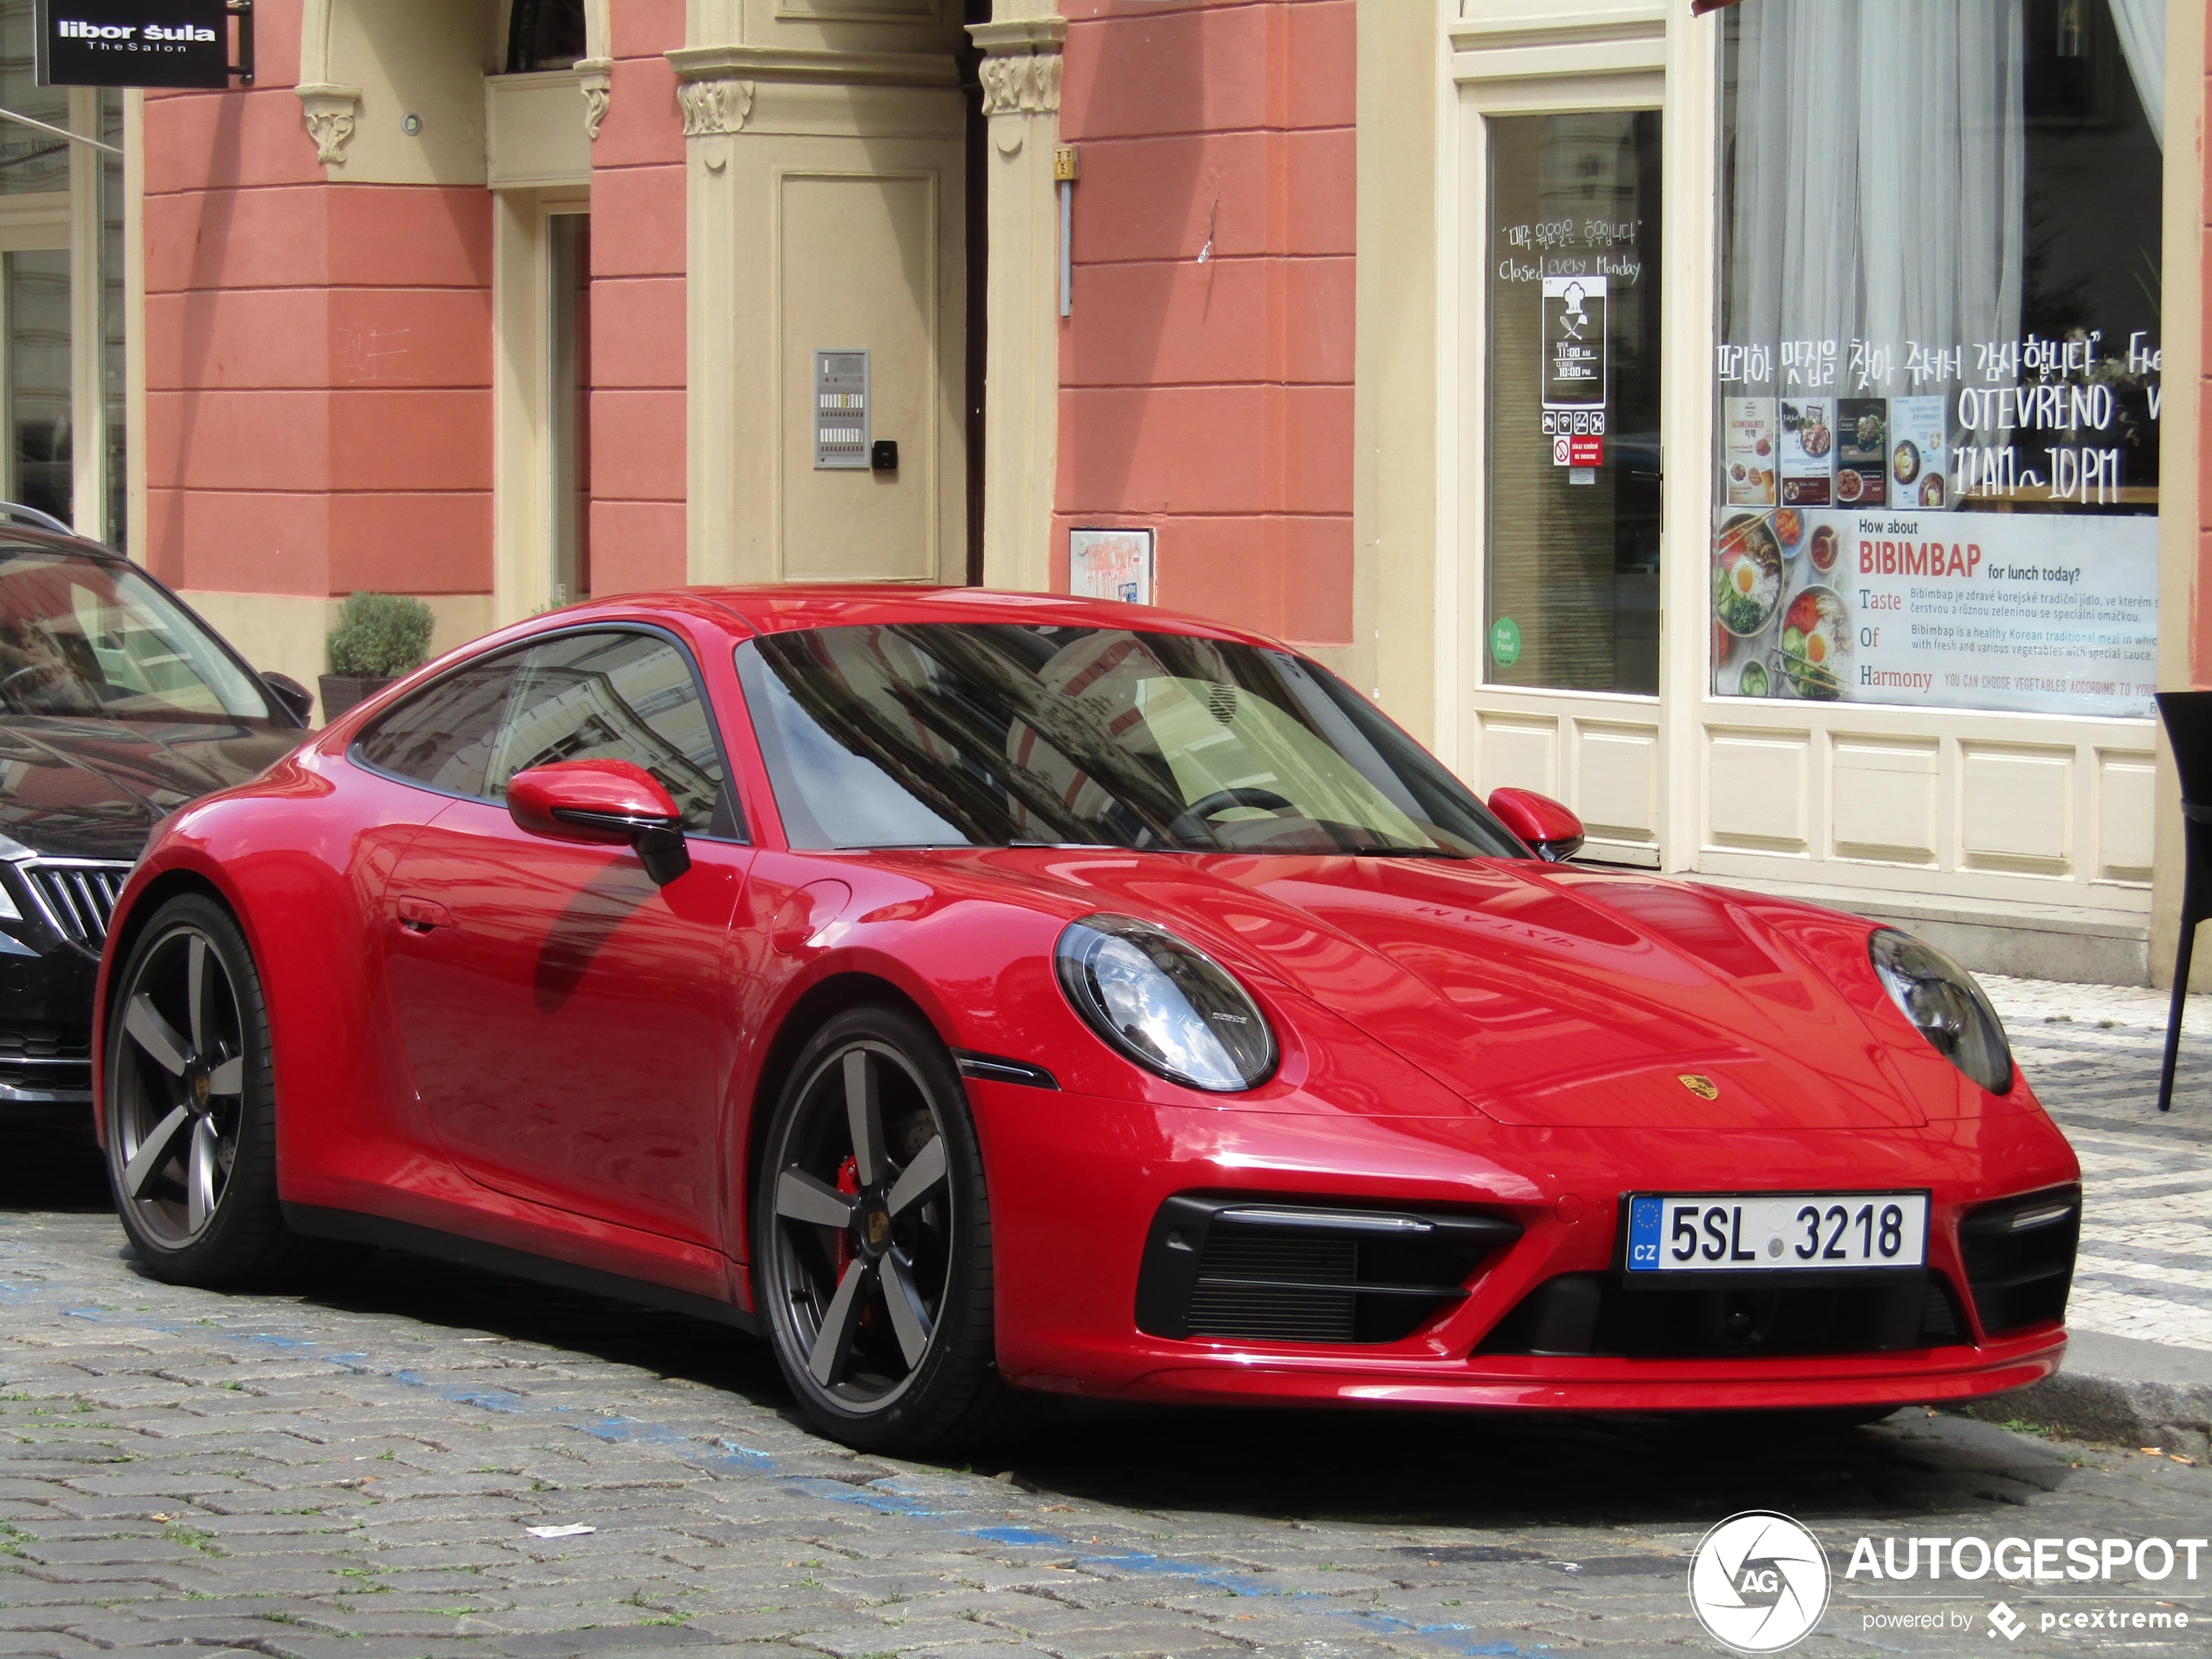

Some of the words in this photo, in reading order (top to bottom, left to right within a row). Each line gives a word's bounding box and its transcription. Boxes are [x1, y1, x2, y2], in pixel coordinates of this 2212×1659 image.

[59, 21, 137, 39] libor
[143, 24, 216, 42] šula
[1499, 255, 1543, 283] Closed
[1548, 258, 1587, 277] every
[1596, 254, 1641, 285] Monday
[1558, 347, 1581, 358] 11:00
[1559, 366, 1581, 378] 10:00
[1716, 343, 1774, 384] 프라하
[1780, 339, 1838, 388] 맛집을
[1850, 338, 1895, 390] 찾아
[1858, 518, 1884, 534] How
[1887, 519, 1919, 535] about
[1858, 540, 1981, 578] BIBIMBAP
[1988, 563, 2006, 580] for
[2007, 564, 2039, 582] lunch
[2042, 566, 2080, 586] today?
[1858, 589, 1902, 610] Taste
[1910, 587, 1953, 603] Bibimbap
[1955, 590, 1964, 603] je
[1966, 589, 1995, 603] zdravé
[1997, 590, 2038, 605] korejské
[2040, 591, 2078, 605] tradiční
[2079, 593, 2103, 608] jídlo,
[2106, 597, 2116, 607] ve
[2118, 596, 2152, 608] kterém
[1910, 603, 1949, 615] čerstvou
[1952, 606, 1957, 615] a
[1959, 603, 1989, 617] různou
[1991, 604, 2037, 618] zeleninou
[2040, 609, 2051, 618] se
[2054, 606, 2094, 622] speciální
[2097, 609, 2141, 623] omáčkou.
[1497, 629, 1511, 640] Bolt
[1859, 626, 1880, 648] Of
[1912, 624, 1954, 638] Bibimbap
[1956, 625, 1965, 637] is
[1966, 627, 1971, 637] a
[1973, 627, 2006, 641] healthy
[2009, 629, 2043, 642] Korean
[2046, 631, 2095, 644] traditional
[2098, 632, 2120, 645] meal
[2122, 633, 2132, 645] in
[1496, 640, 1514, 651] Food
[1912, 638, 1932, 650] with
[1933, 638, 1957, 651] fresh
[1959, 642, 1975, 652] and
[1977, 643, 2009, 654] various
[2012, 644, 2063, 658] vegetables
[2066, 645, 2086, 658] with
[2088, 648, 2121, 661] special
[2123, 650, 2155, 661] sauce.
[1859, 664, 1932, 694] Harmony
[1944, 672, 1960, 687] YOU
[1962, 674, 1979, 689] CAN
[1981, 675, 2011, 691] CHOOSE
[2014, 677, 2067, 693] VEGETABLES
[2069, 680, 2115, 696] ACCORDING
[2120, 682, 2130, 697] TO
[1671, 1205, 1756, 1261] 5SL
[1794, 1204, 1904, 1260] 3218
[1634, 1244, 1656, 1261] CZ
